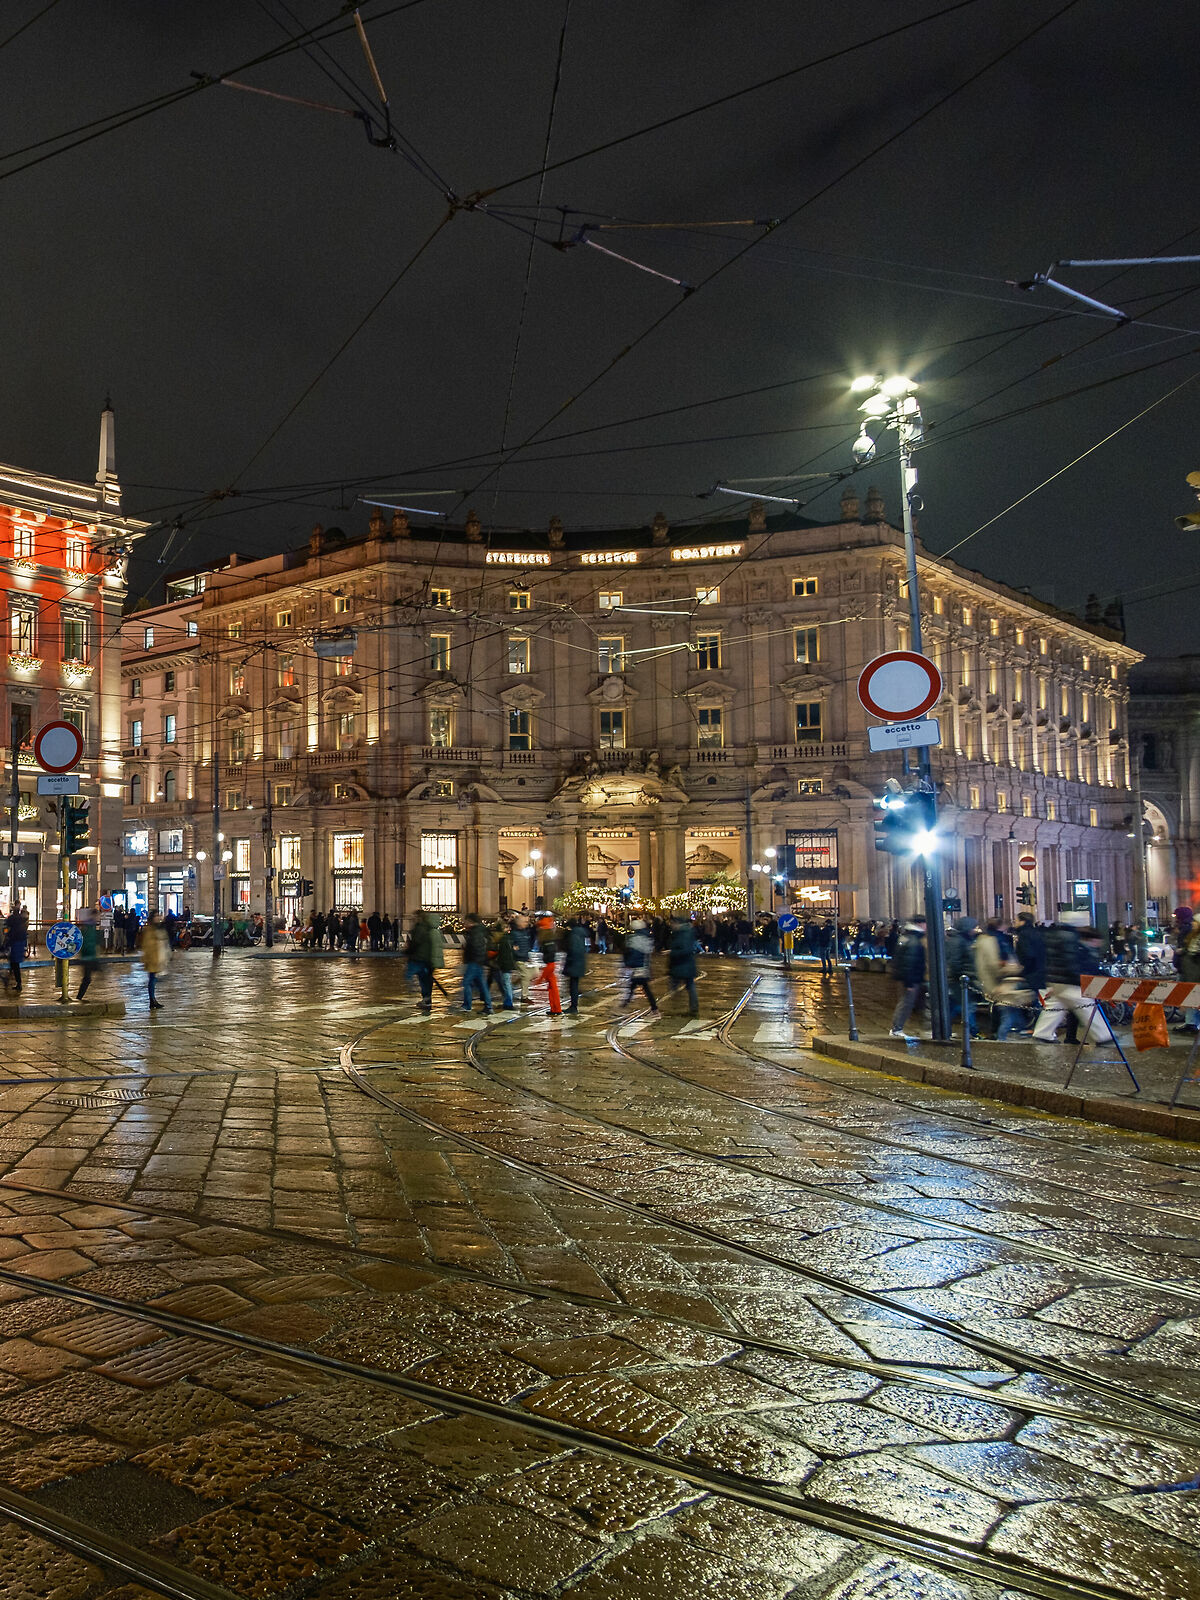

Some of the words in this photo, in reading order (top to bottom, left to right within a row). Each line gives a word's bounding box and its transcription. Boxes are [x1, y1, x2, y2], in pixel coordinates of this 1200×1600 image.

[485, 552, 550, 564] STARBUCKS
[581, 551, 637, 564] RESERVE
[673, 545, 741, 560] ROASTERY
[885, 725, 921, 734] eccetto
[78, 862, 88, 872] M
